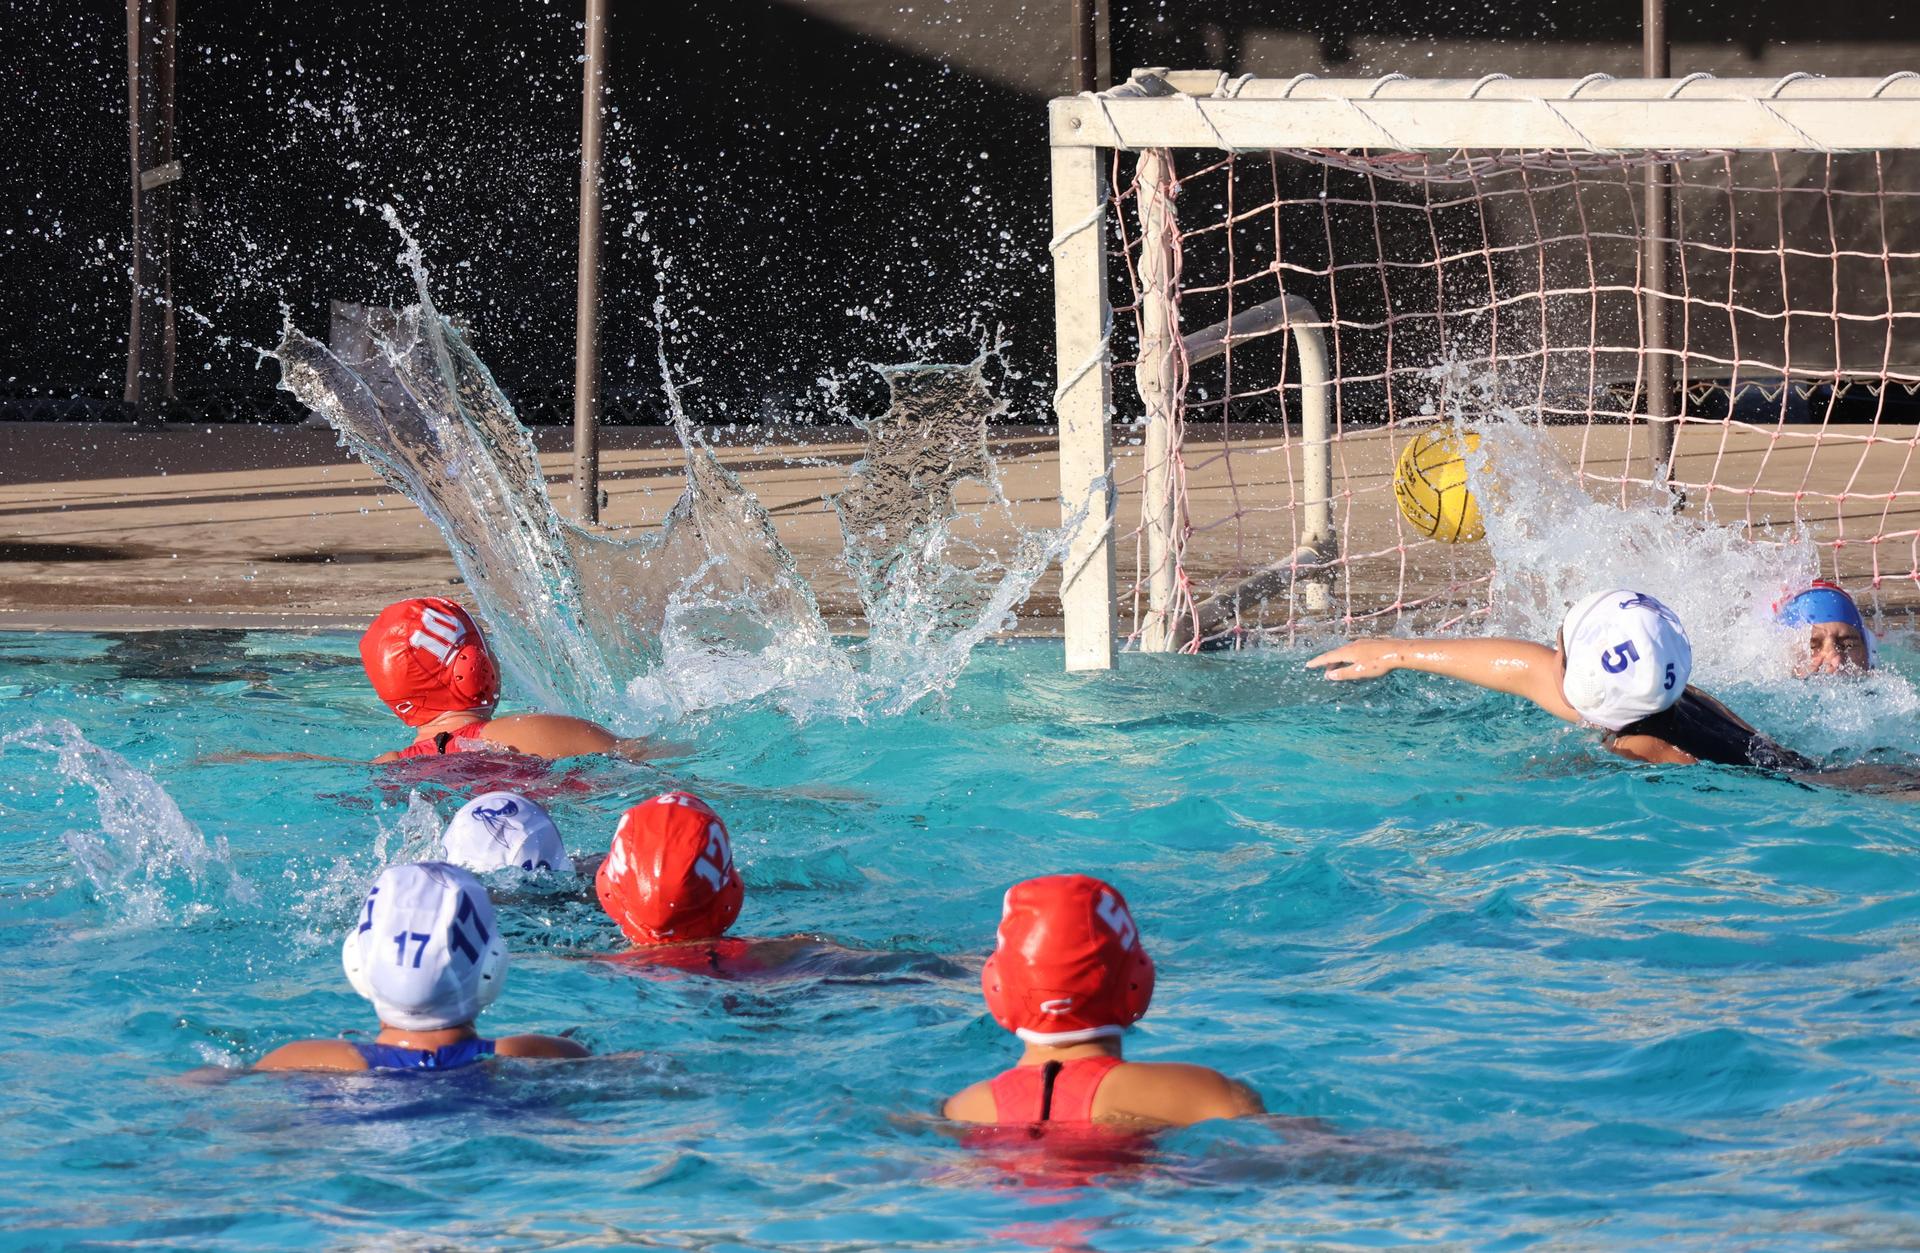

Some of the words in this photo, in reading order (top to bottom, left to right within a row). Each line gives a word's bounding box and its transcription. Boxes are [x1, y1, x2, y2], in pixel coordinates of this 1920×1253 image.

[409, 607, 467, 666] 10
[1601, 639, 1641, 674] 5
[1663, 662, 1677, 690] 5
[693, 821, 732, 892] 12
[393, 930, 431, 969] 17
[451, 890, 490, 966] 17
[1096, 888, 1137, 952] 5
